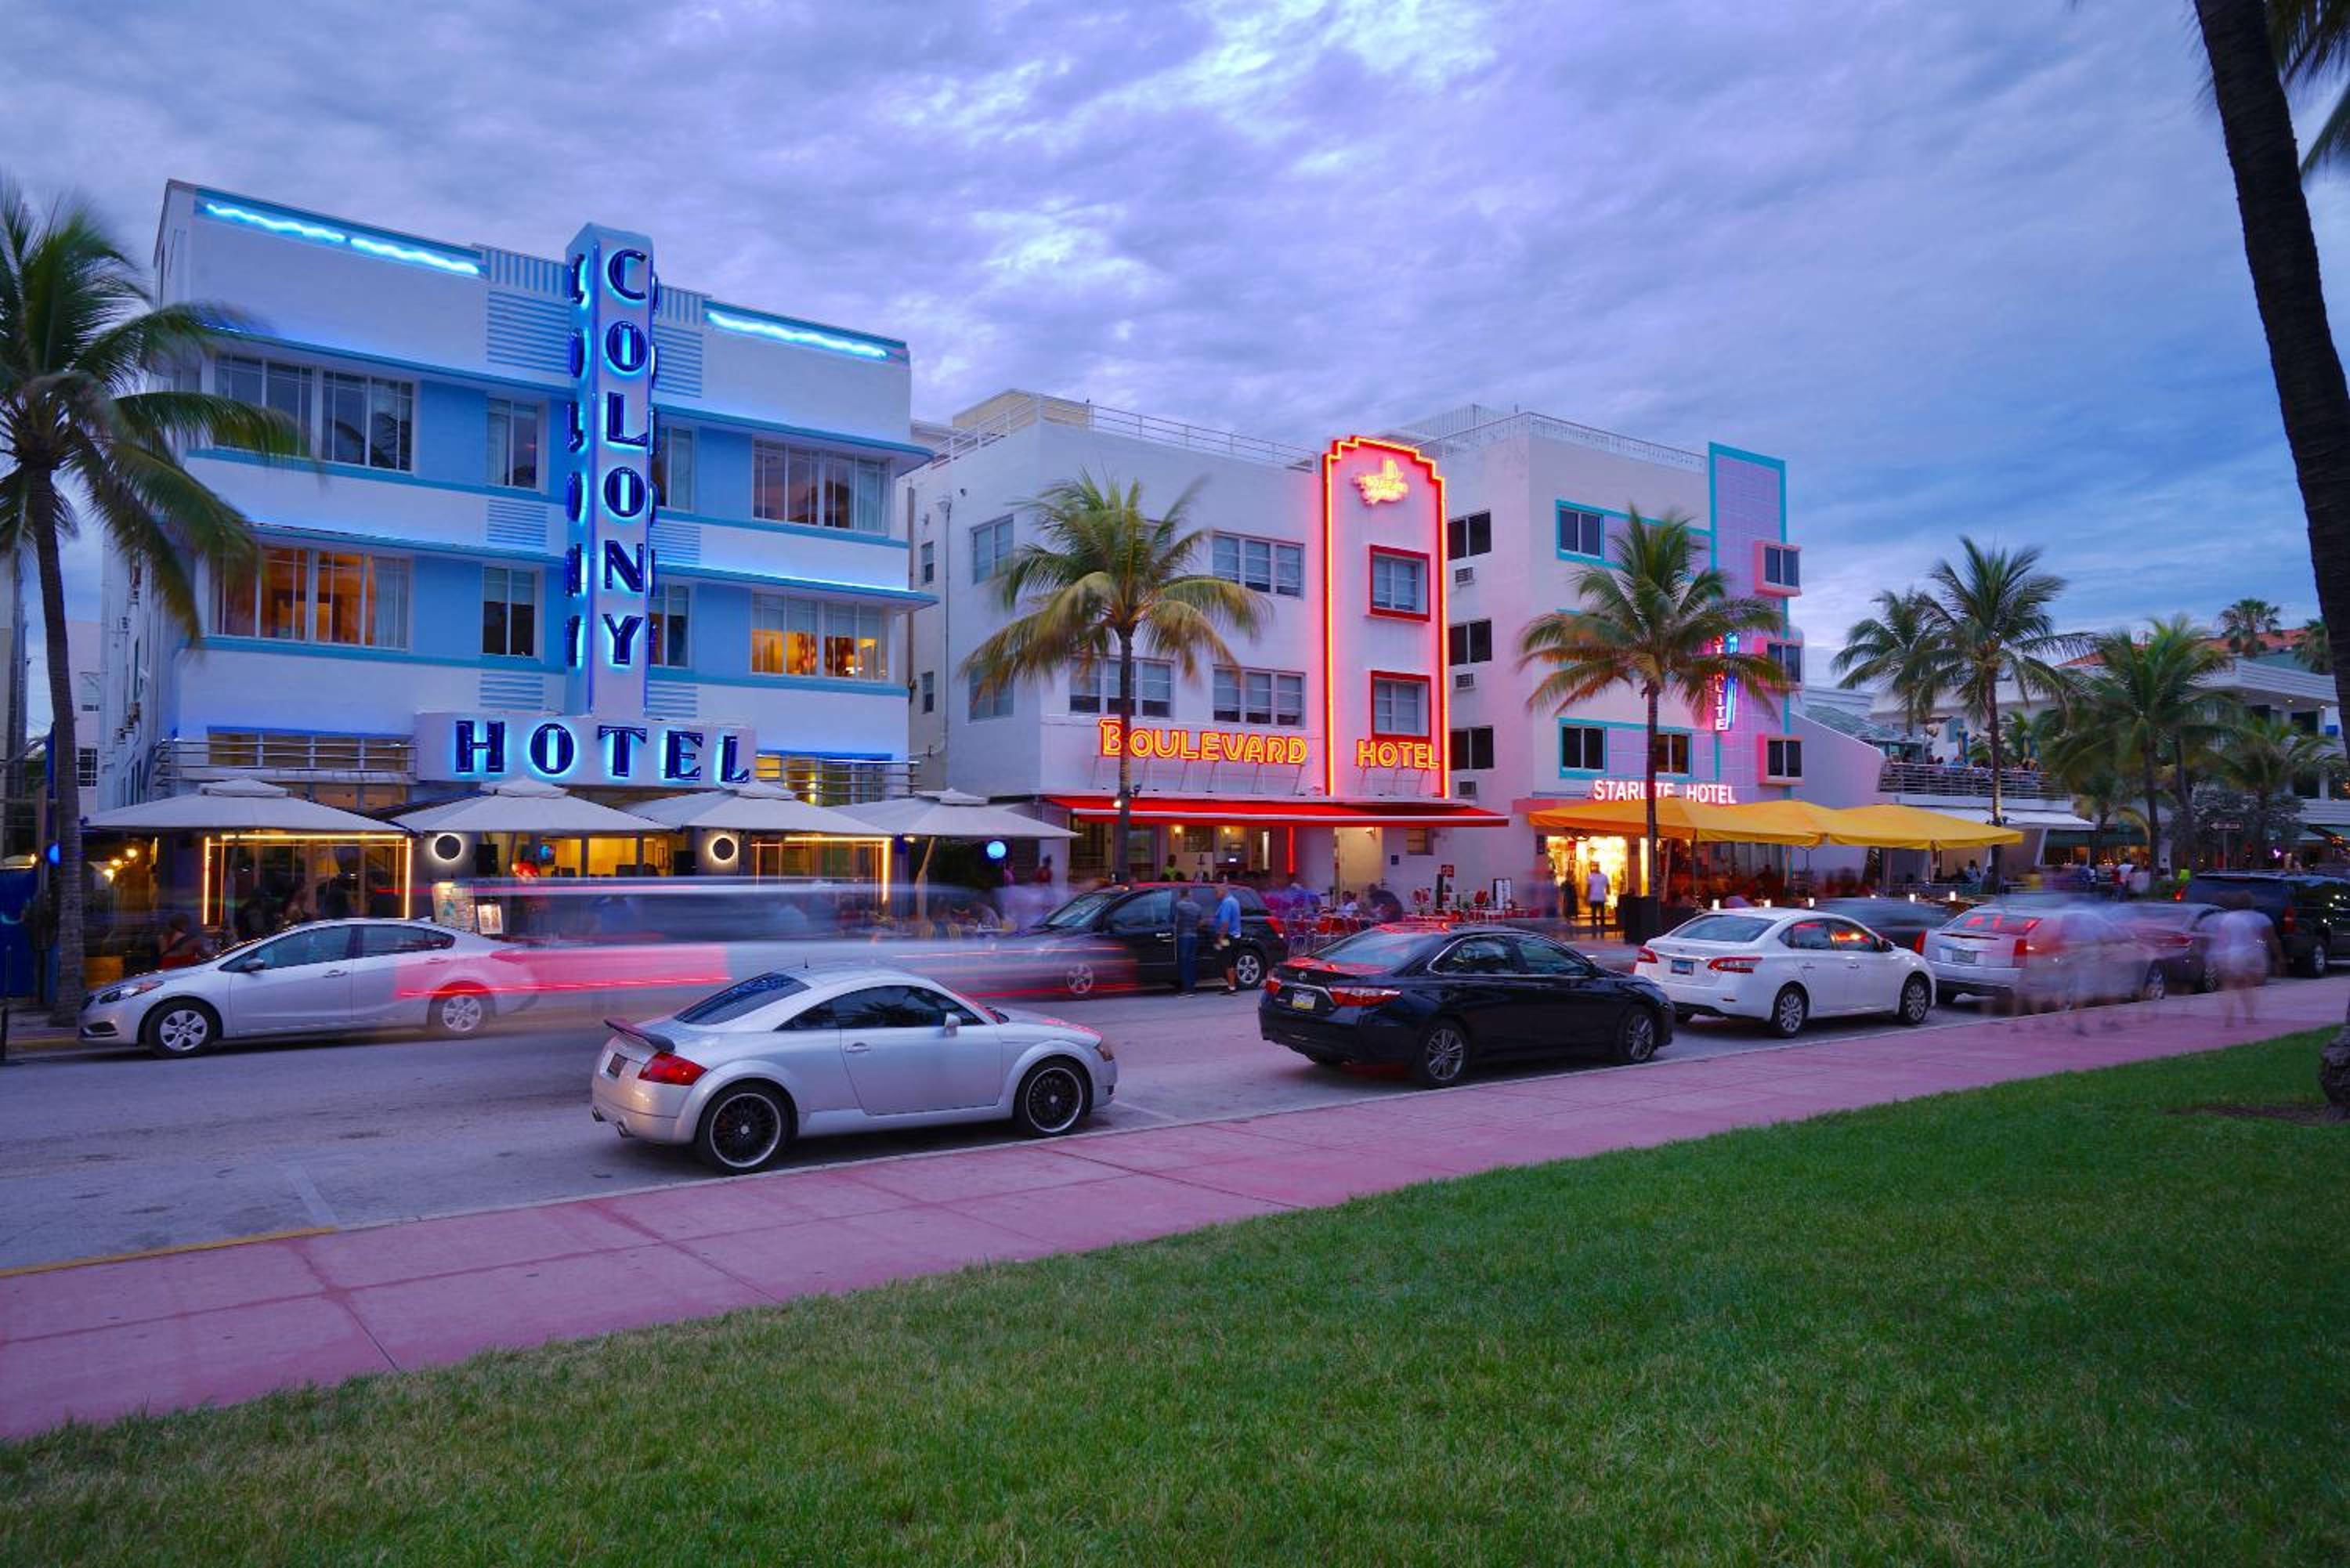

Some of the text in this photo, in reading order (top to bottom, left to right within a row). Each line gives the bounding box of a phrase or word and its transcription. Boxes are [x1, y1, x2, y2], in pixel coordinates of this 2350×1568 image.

[602, 247, 649, 667] COLONY
[454, 719, 751, 783] HOTEL
[1098, 717, 1308, 765] BOULEVARD
[1356, 739, 1441, 770] HOTEL
[1593, 779, 1737, 805] STARLTE HOTEL
